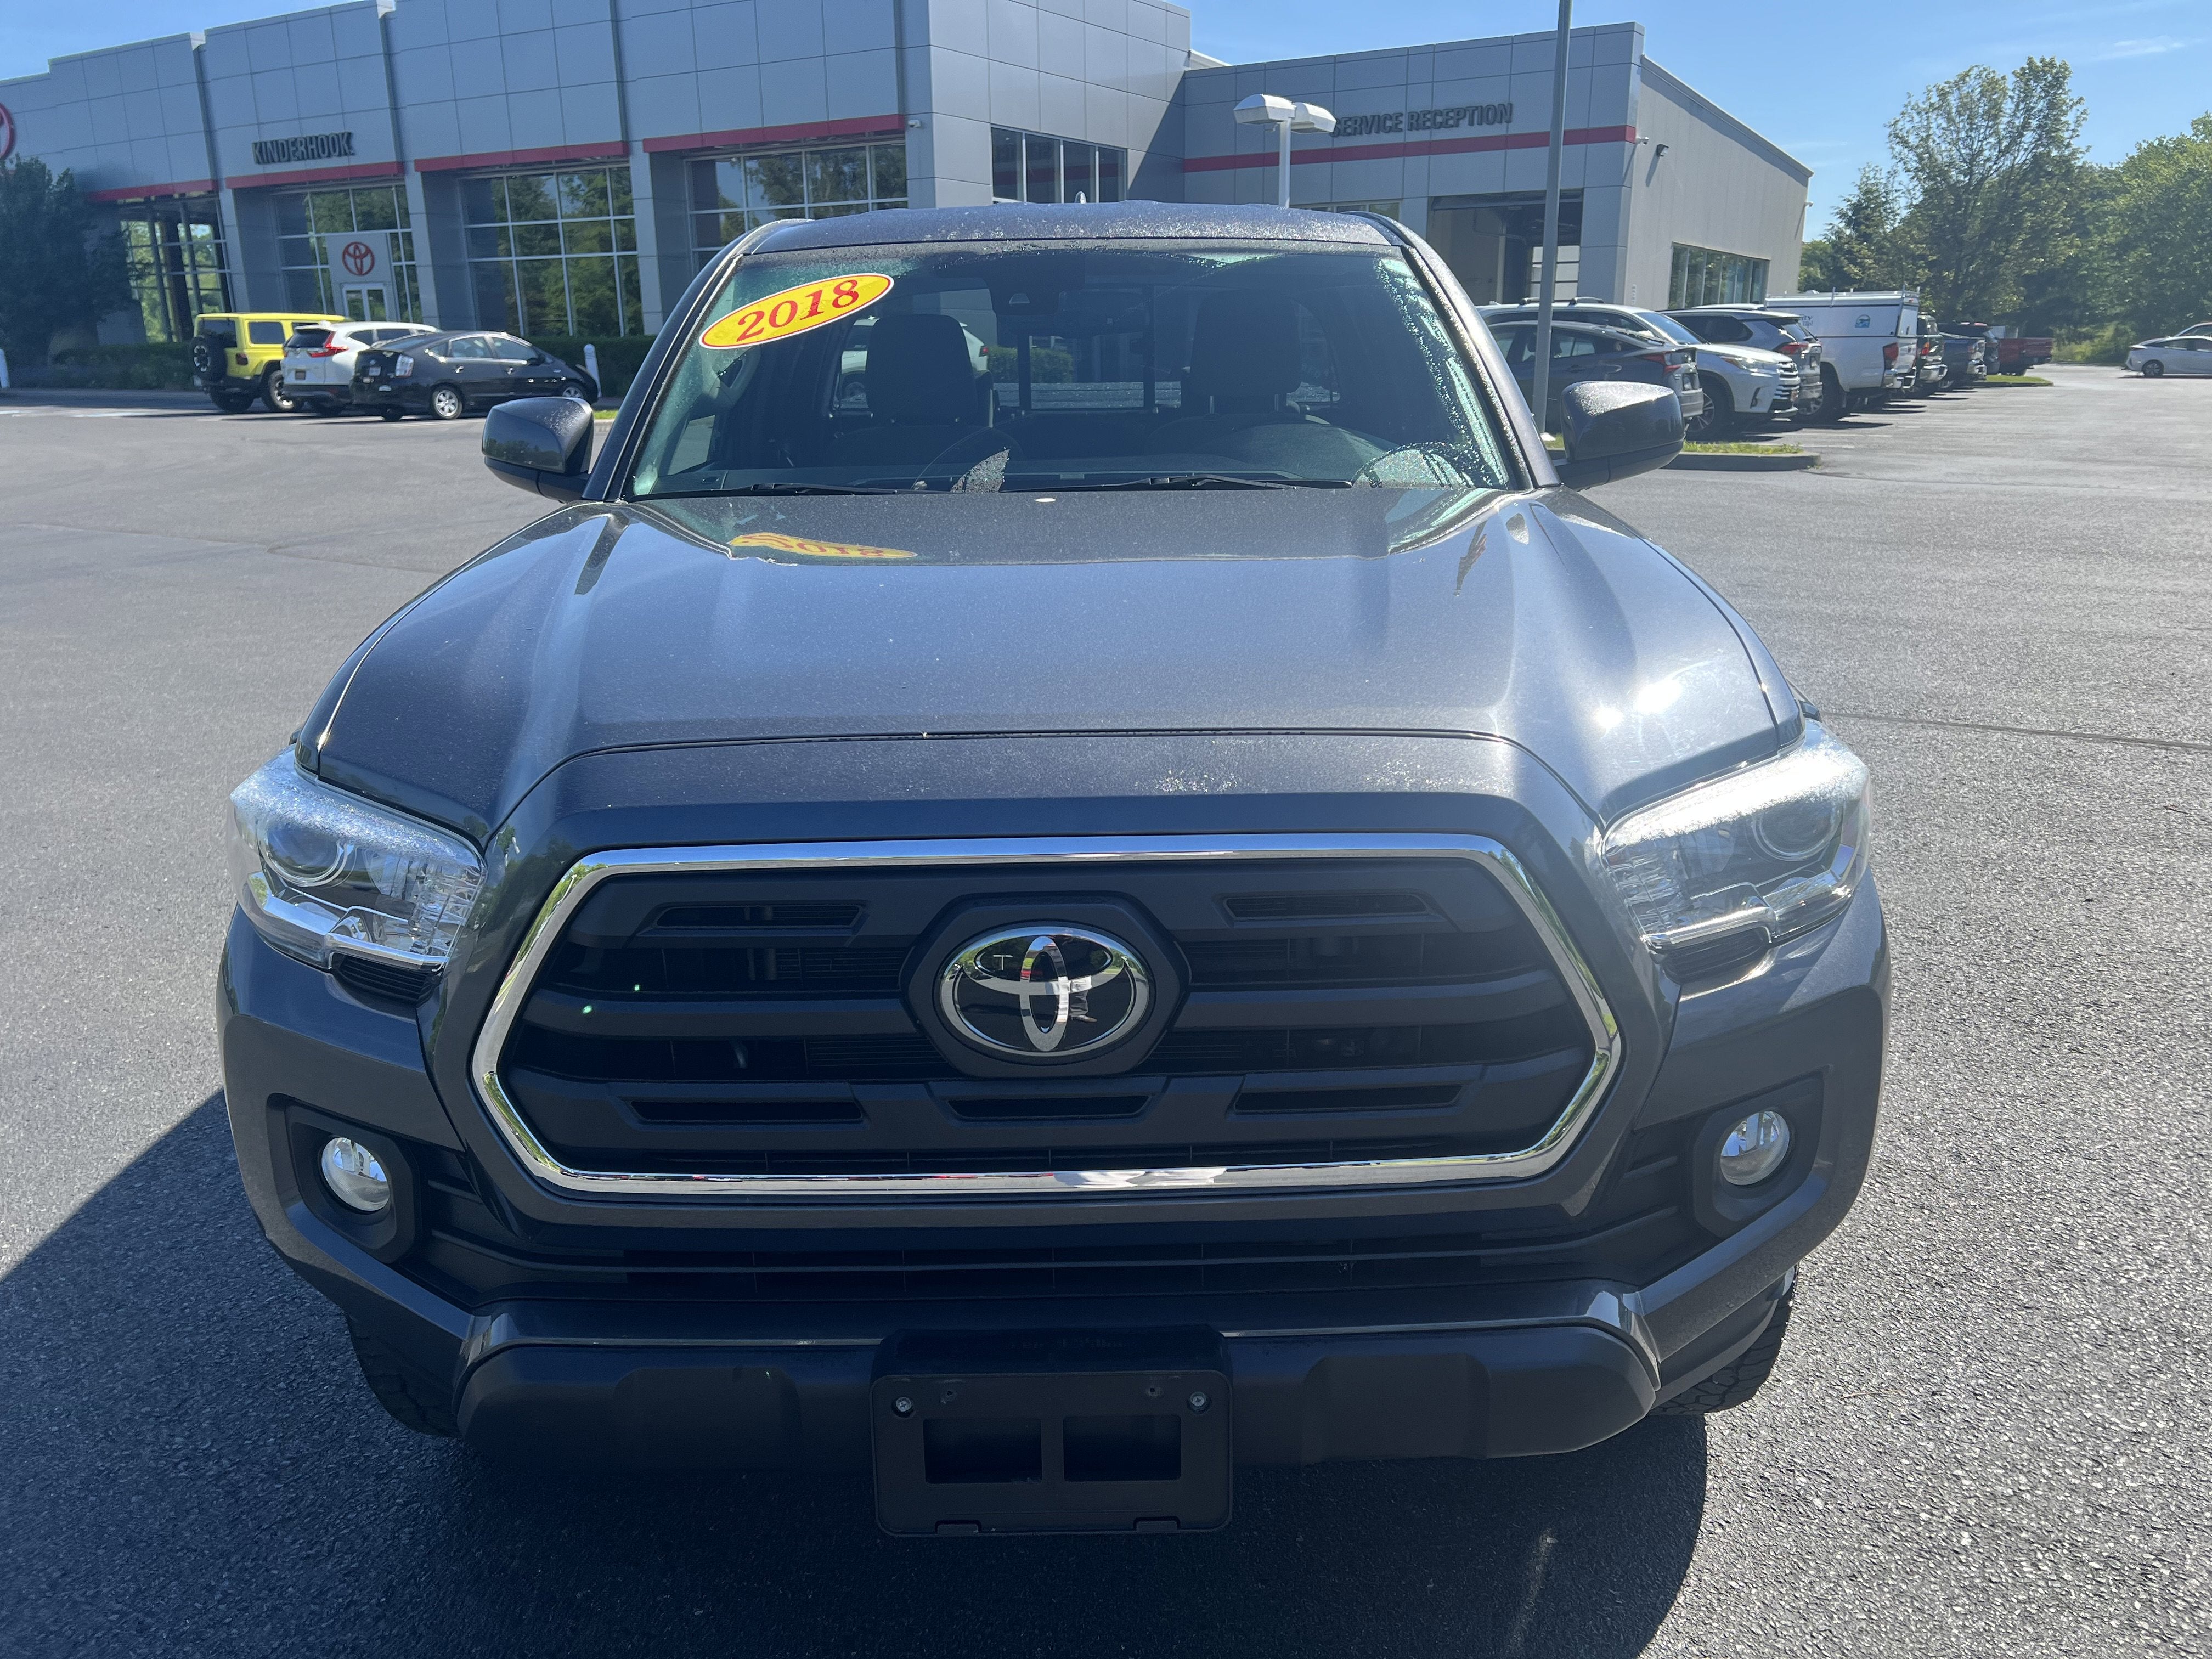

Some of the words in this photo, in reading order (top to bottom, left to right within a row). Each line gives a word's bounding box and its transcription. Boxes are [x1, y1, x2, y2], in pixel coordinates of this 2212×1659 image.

[1331, 112, 1404, 137] SERVICE
[1407, 103, 1513, 131] RECEPTION
[252, 131, 355, 165] KINDERHOOK
[736, 279, 859, 342] 2018
